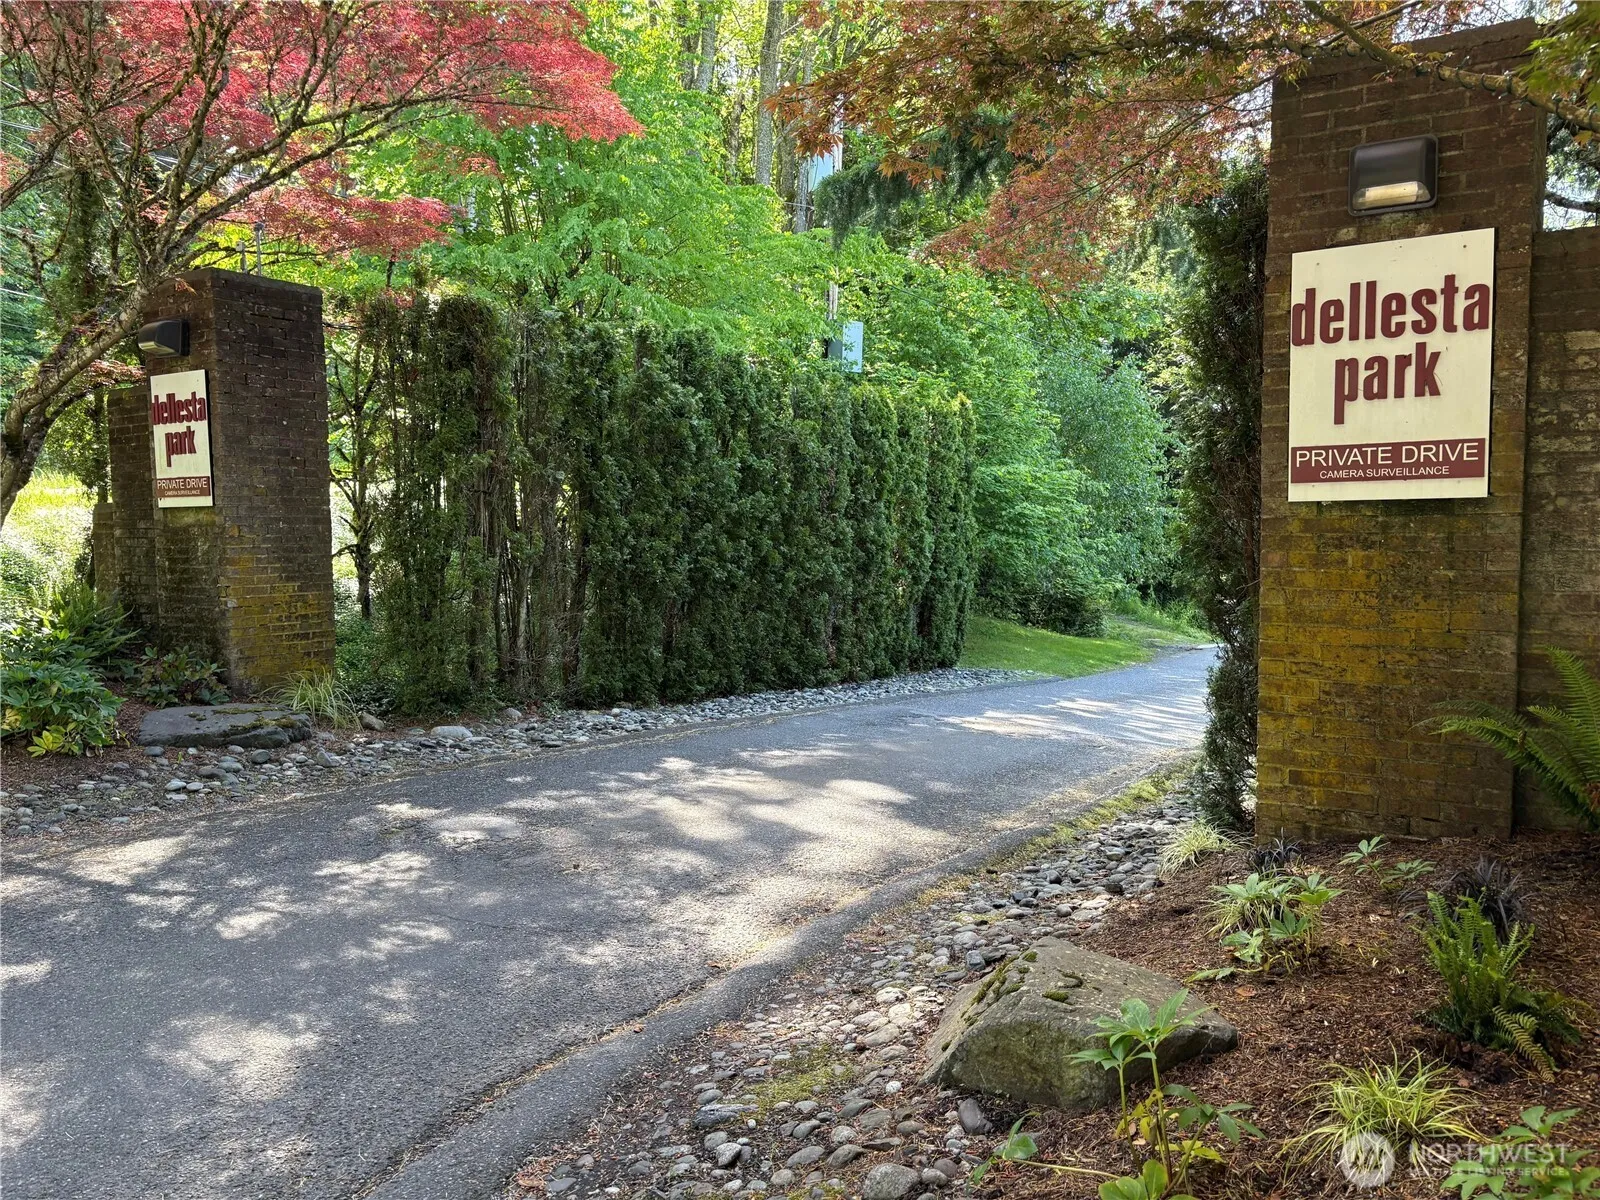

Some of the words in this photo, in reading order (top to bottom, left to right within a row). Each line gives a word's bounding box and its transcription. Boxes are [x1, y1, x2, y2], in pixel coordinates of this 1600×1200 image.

[1291, 274, 1490, 347] dellesta
[1333, 342, 1442, 425] park
[151, 391, 207, 426] dellesta
[165, 425, 197, 468] park
[1296, 446, 1393, 468] PRIVATE
[1401, 442, 1479, 464] DRIVE
[157, 479, 185, 490] PRIVATE
[186, 477, 208, 489] DRIVE
[1319, 469, 1365, 479] CAMERA
[1366, 465, 1450, 477] SURVEILLANCE
